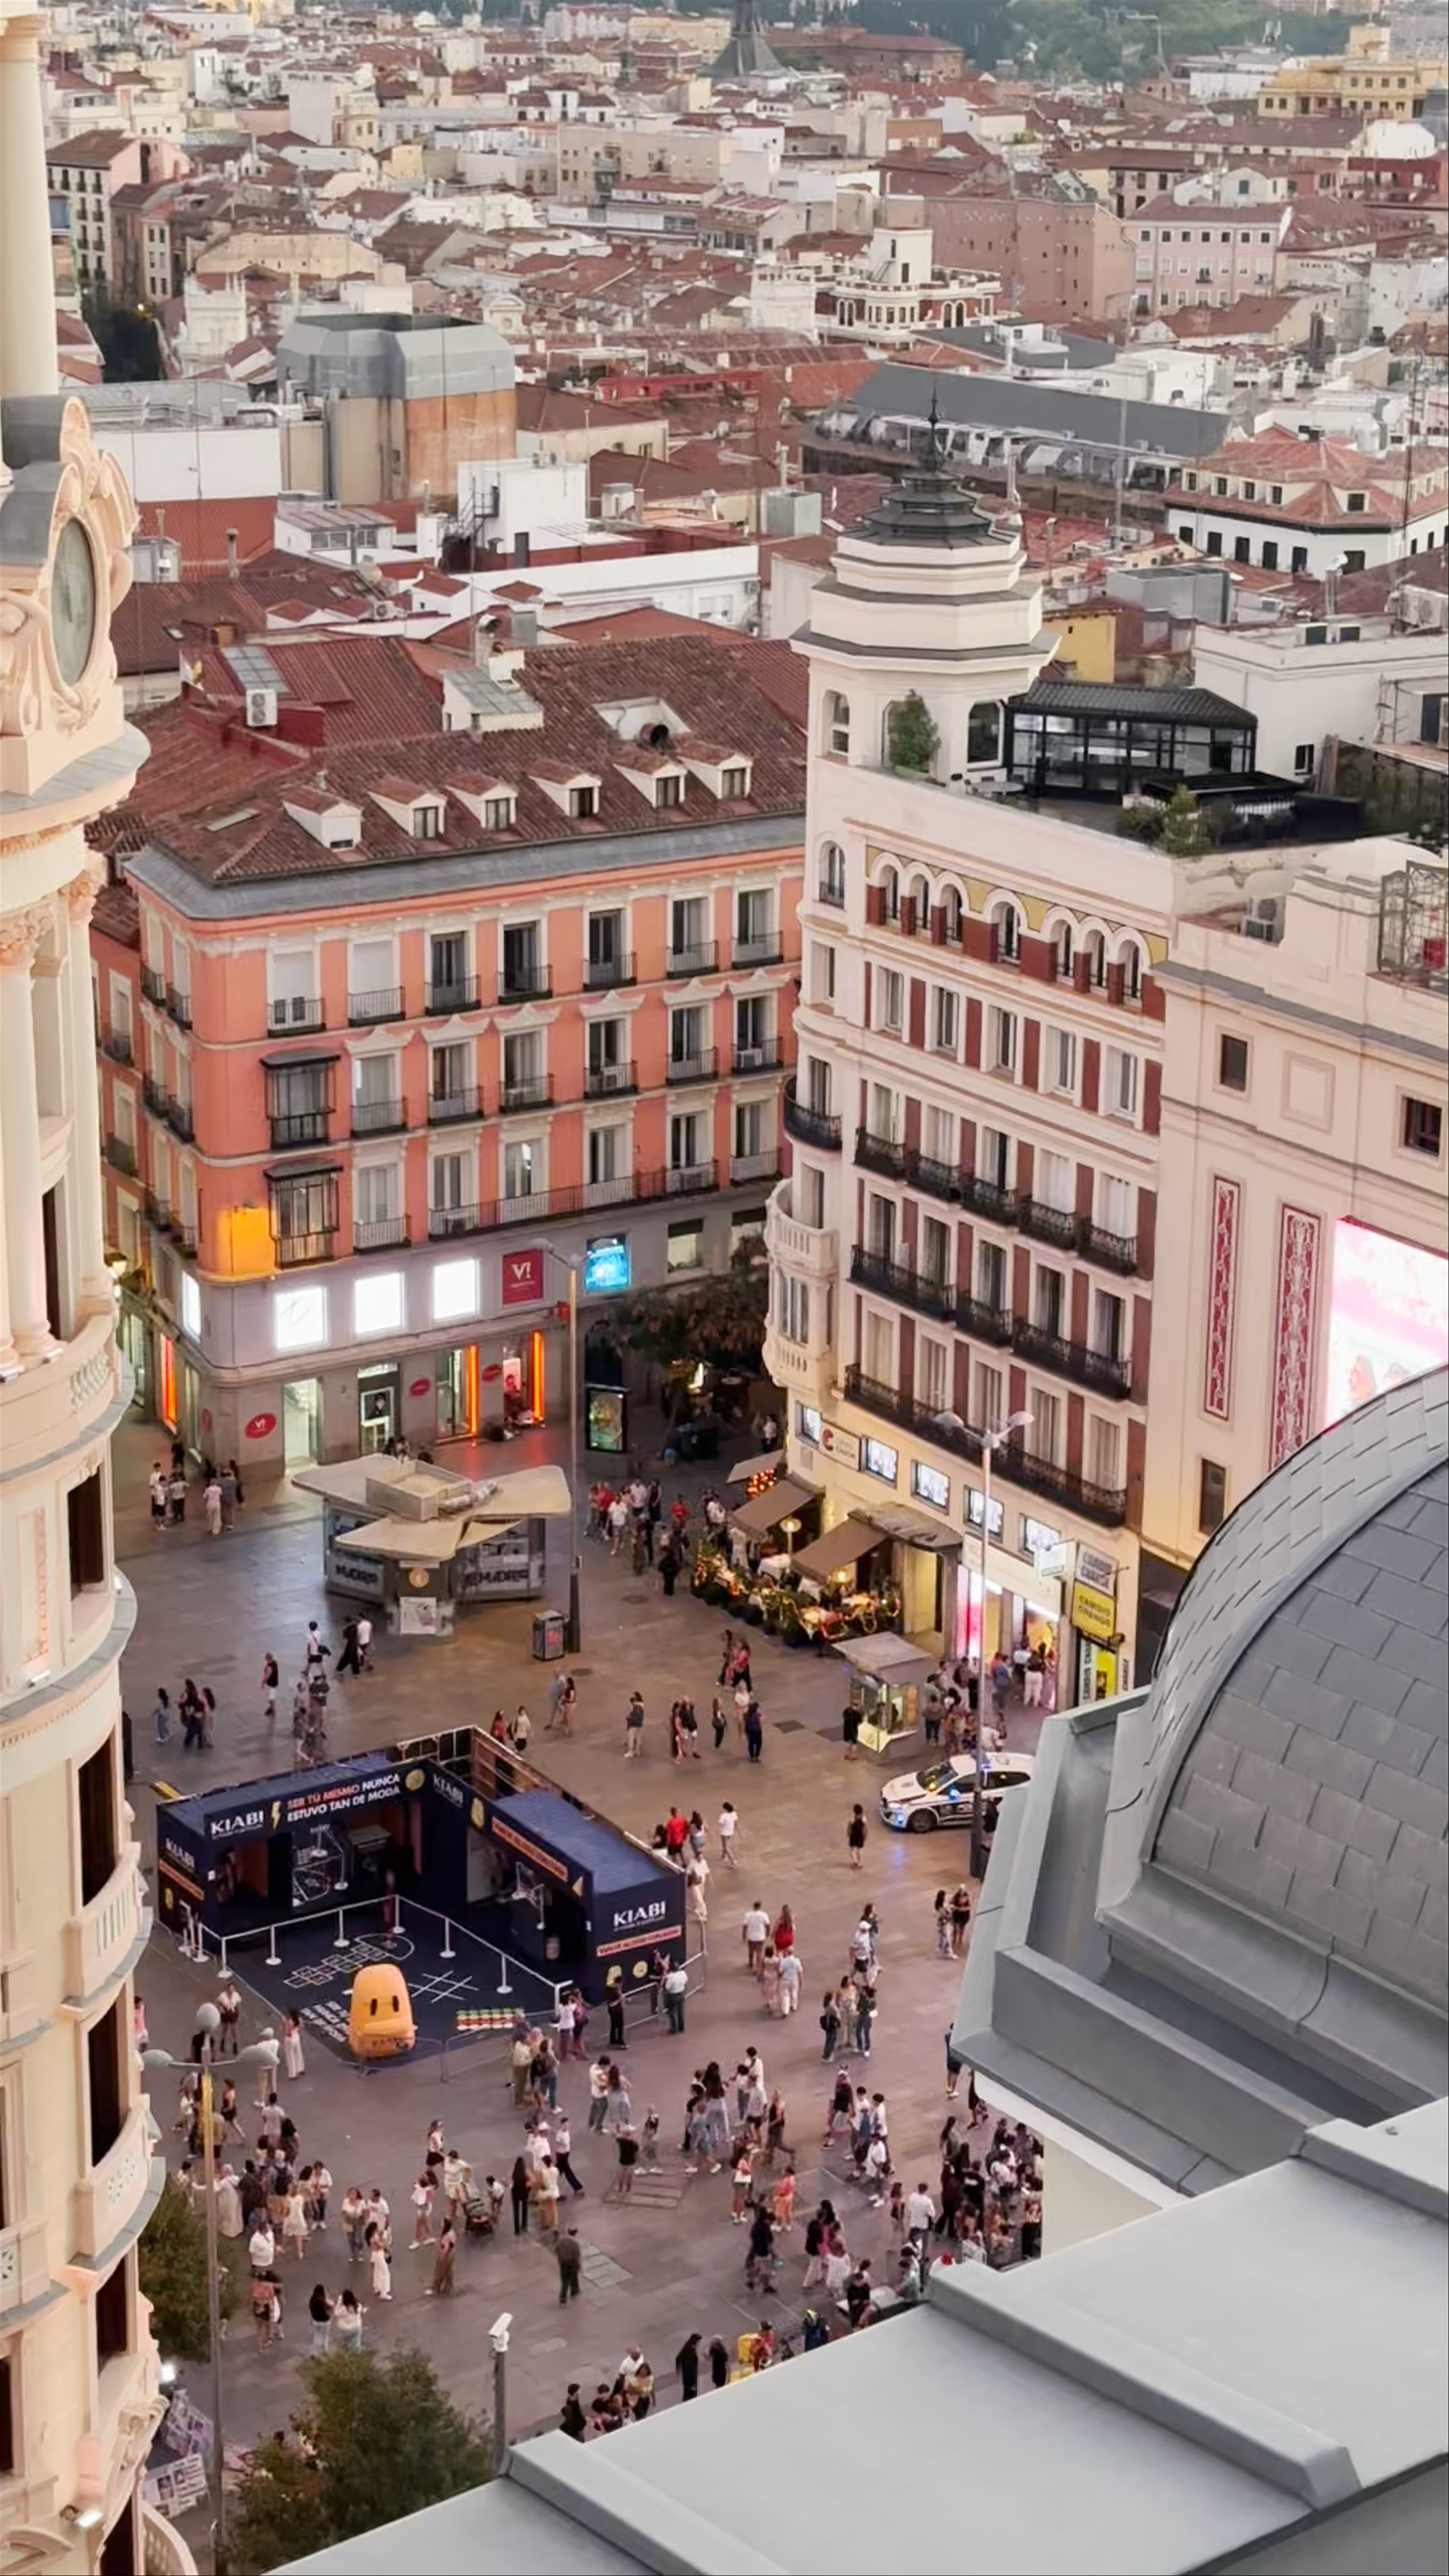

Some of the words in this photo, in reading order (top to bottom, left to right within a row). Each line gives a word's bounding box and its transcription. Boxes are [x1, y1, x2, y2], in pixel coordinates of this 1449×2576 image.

[362, 1773, 400, 1791] NUNCA
[433, 1773, 463, 1804] KIABI
[287, 1804, 327, 1822] ESTUVO
[329, 1798, 351, 1811] TAN
[352, 1794, 365, 1806] DE
[368, 1786, 401, 1802] MODA
[211, 1810, 263, 1835] KIABI
[614, 1900, 666, 1927] KIABI
